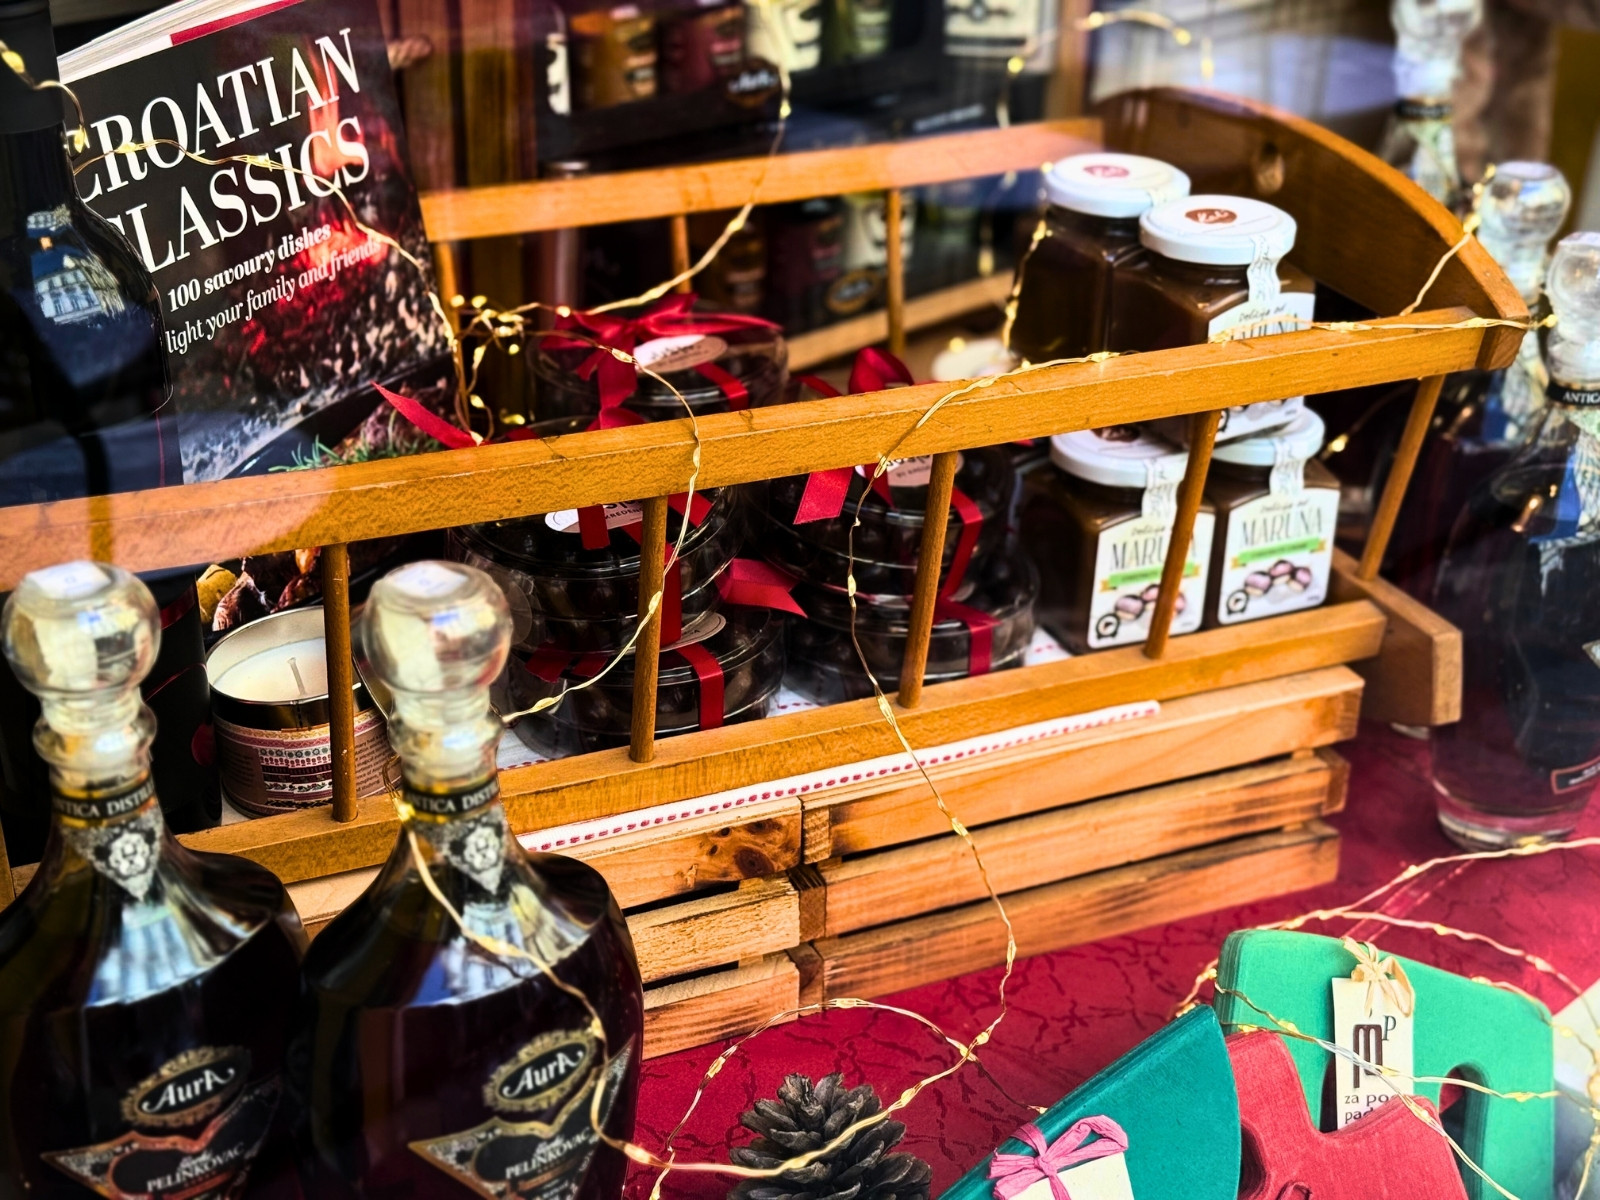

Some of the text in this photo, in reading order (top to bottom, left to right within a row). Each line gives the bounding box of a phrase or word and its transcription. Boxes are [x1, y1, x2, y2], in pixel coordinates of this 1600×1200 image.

[105, 116, 370, 274] LASSICS
[168, 223, 332, 313] 100 savoury dishes
[205, 301, 244, 341] your
[245, 274, 296, 321] family
[298, 263, 329, 290] and
[327, 235, 382, 282] friends
[1562, 391, 1600, 404] ANTIC
[1241, 508, 1322, 547] MARUNA
[1344, 1094, 1360, 1105] za
[505, 1126, 590, 1179] PELINKOVAC
